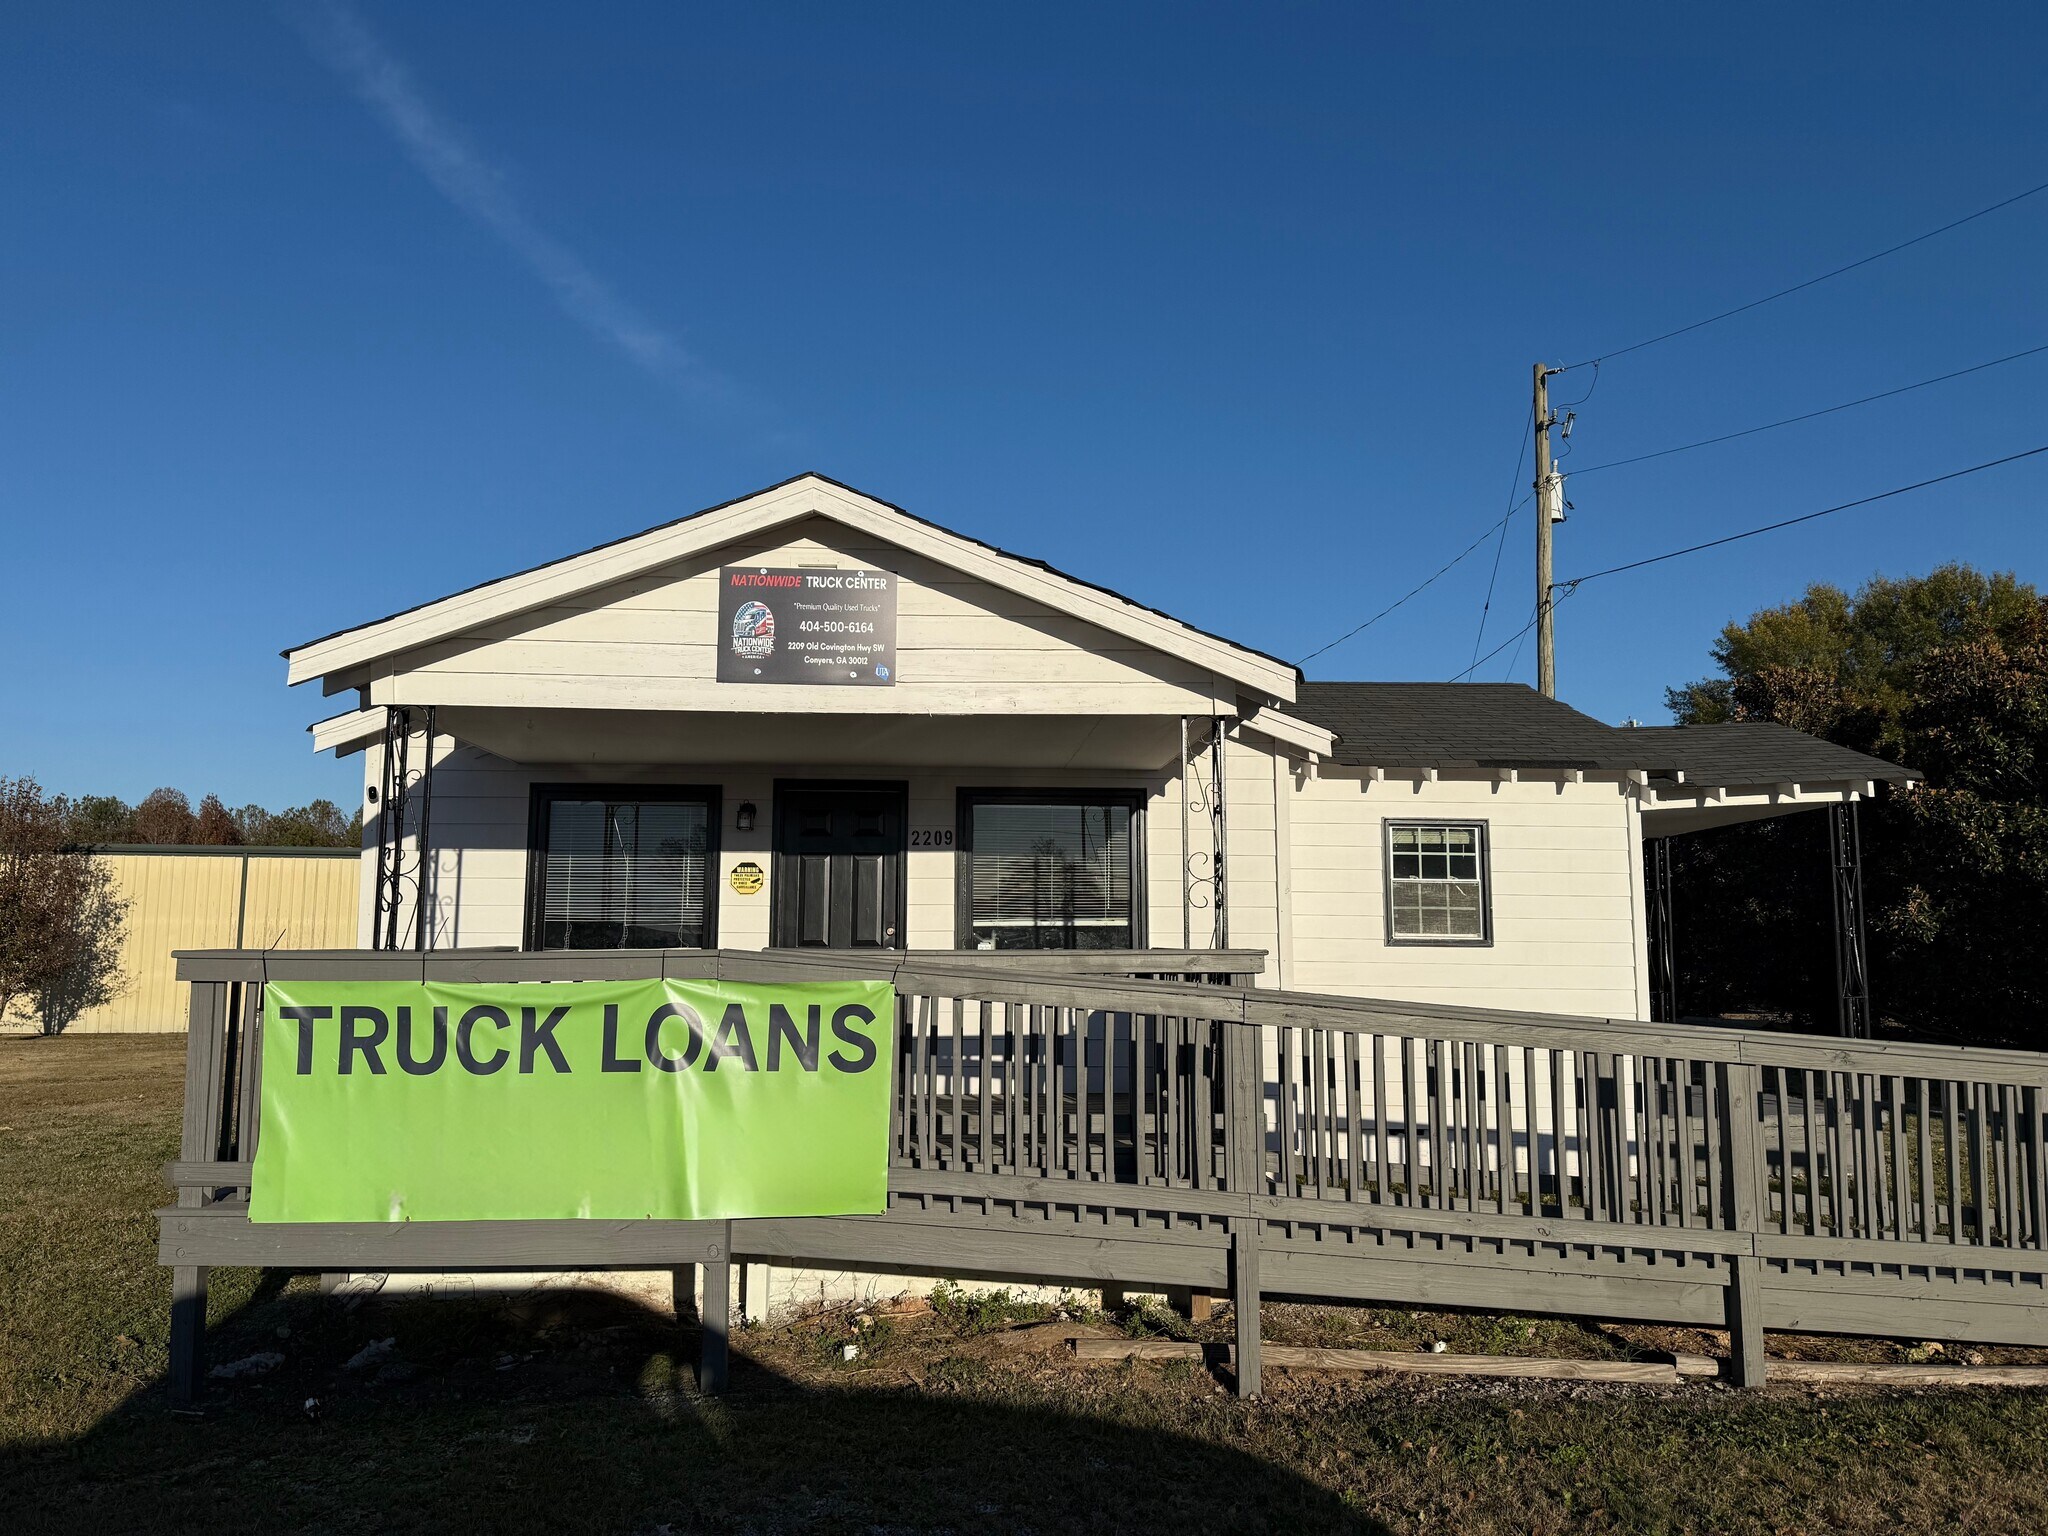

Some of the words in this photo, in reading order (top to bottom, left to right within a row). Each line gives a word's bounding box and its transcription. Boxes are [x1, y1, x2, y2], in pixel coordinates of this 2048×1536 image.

[731, 575, 802, 587] NATIONWIDE
[806, 576, 843, 588] TRUCK
[845, 577, 887, 590] CENTER
[822, 603, 843, 612] Quality
[799, 621, 874, 633] 404-500-6164
[733, 637, 775, 648] NATIONWIDE
[787, 642, 805, 650] 2209
[806, 642, 819, 650] Old
[820, 642, 856, 653] Covington
[856, 644, 871, 653] Hwy
[872, 643, 885, 652] SW
[735, 645, 752, 654] TRUCK
[752, 645, 772, 655] CENTER
[804, 656, 835, 665] Conyers,
[836, 656, 848, 665] GA
[848, 657, 868, 665] 30012
[911, 830, 953, 846] 2209
[279, 1005, 573, 1076] TRUCK
[601, 1003, 878, 1074] LOANS
